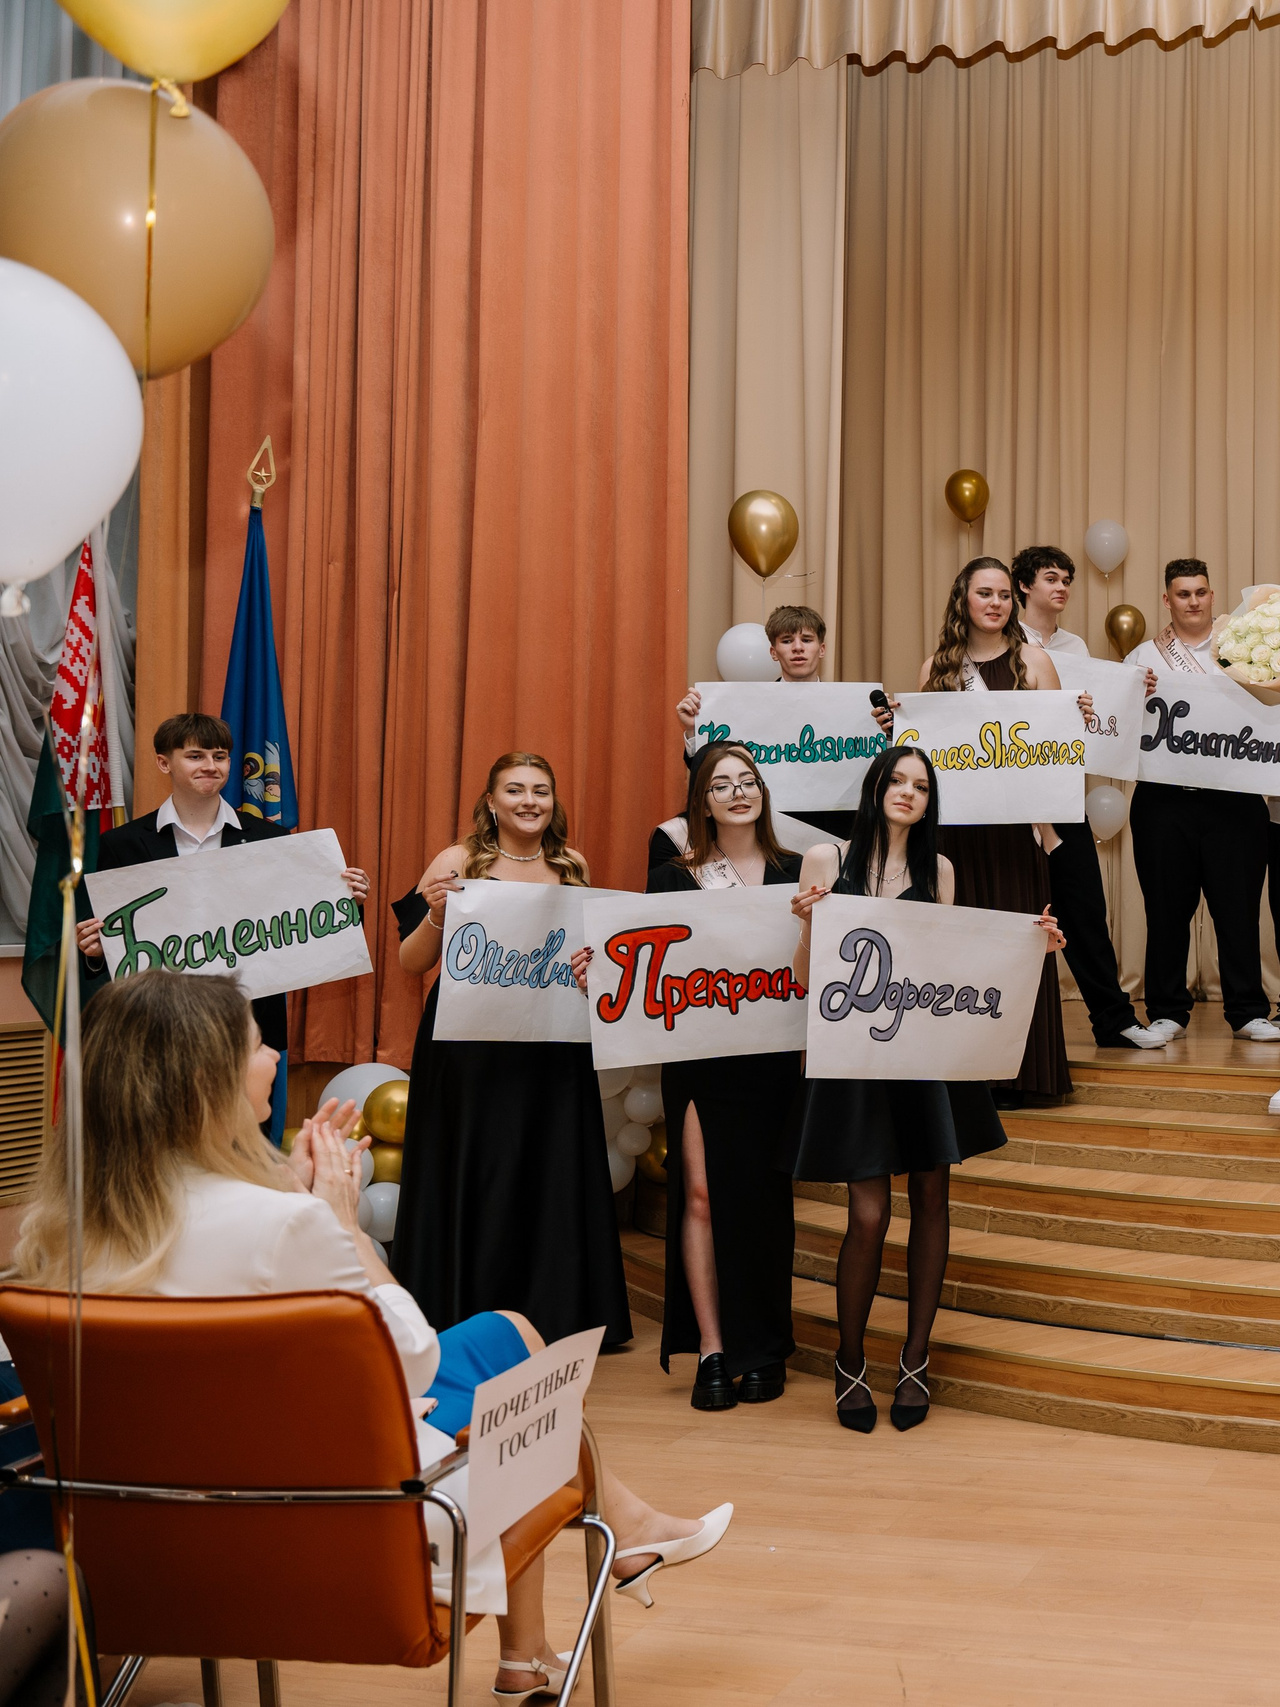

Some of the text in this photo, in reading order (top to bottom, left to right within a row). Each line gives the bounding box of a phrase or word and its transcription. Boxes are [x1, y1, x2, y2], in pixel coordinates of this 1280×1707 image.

[101, 886, 361, 980] Бесценная
[597, 924, 809, 1031] Прекрасн
[820, 927, 1003, 1042] Дорогая
[478, 1358, 585, 1439] ПОЧЕТНЫЕ
[498, 1406, 559, 1468] ГОСТИ
